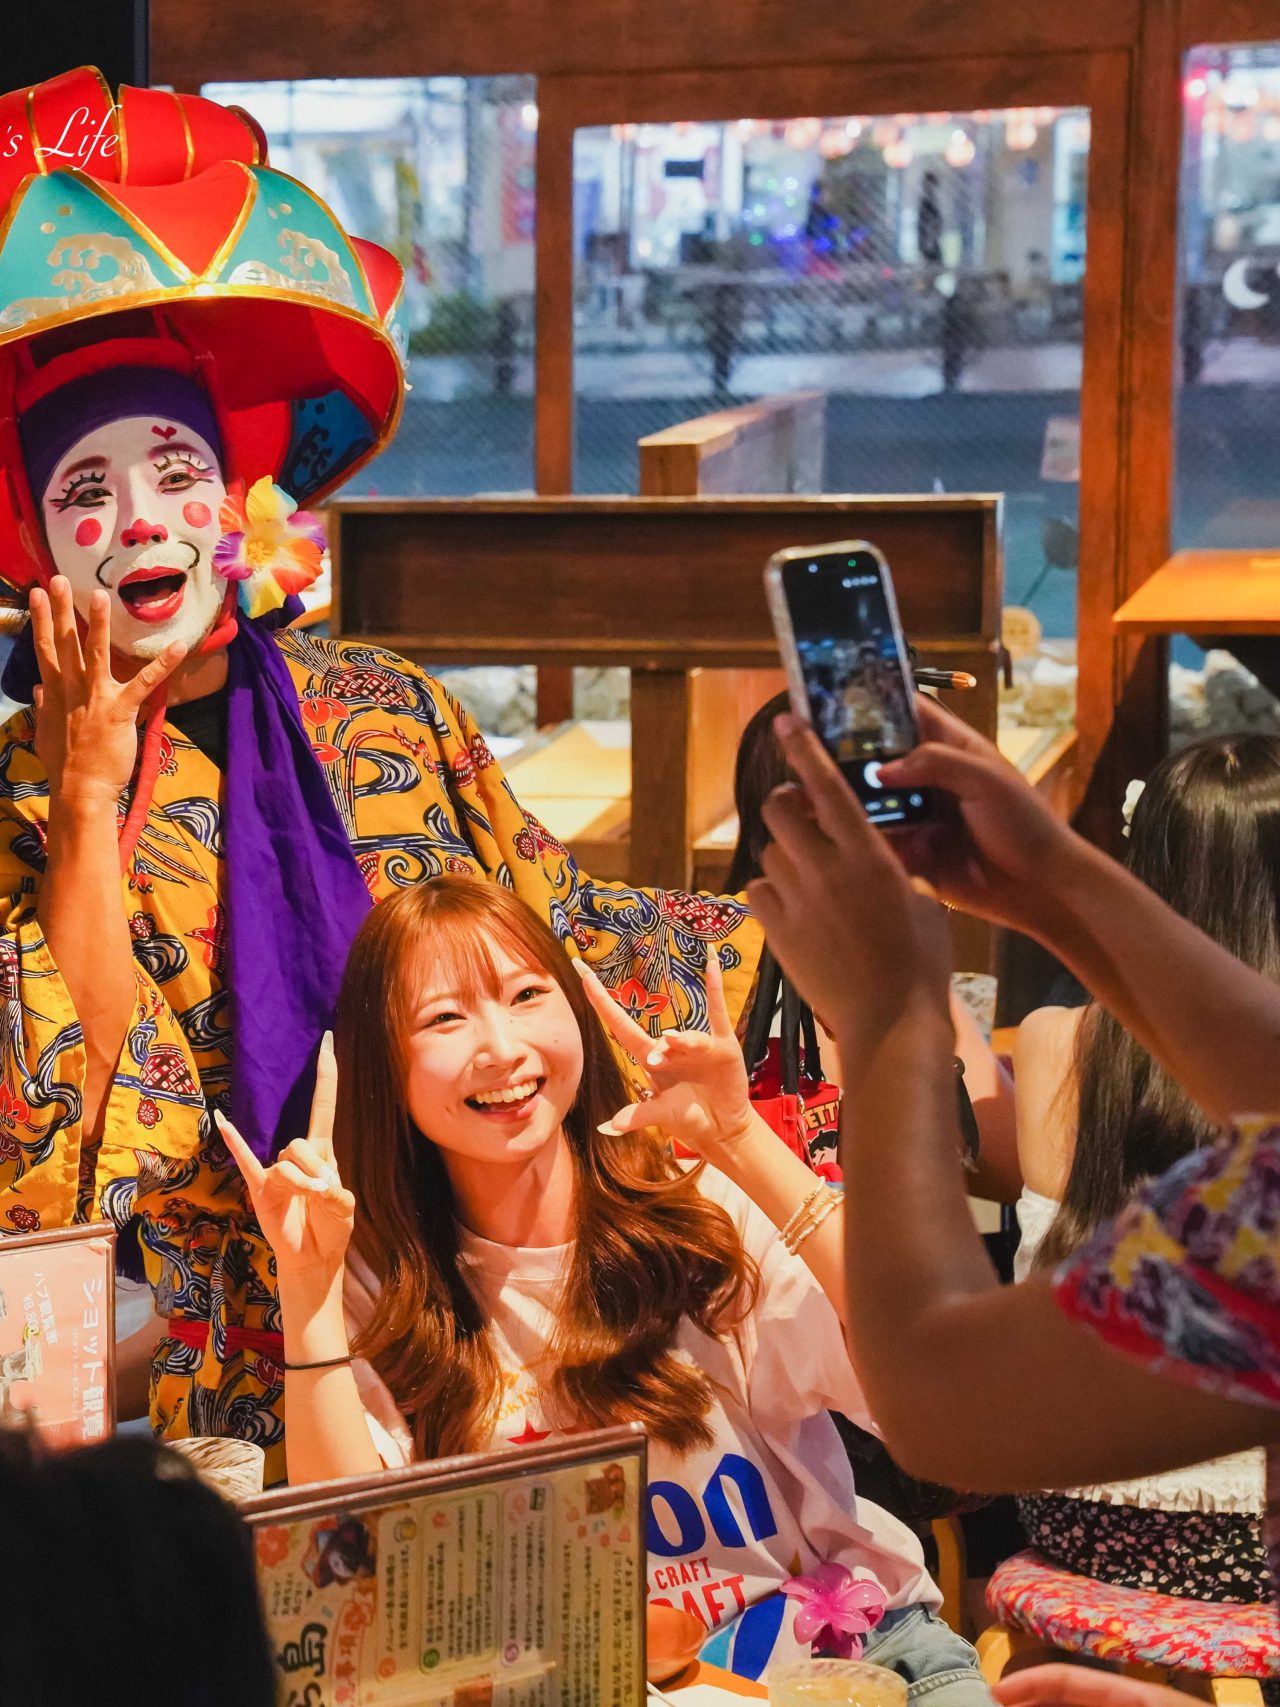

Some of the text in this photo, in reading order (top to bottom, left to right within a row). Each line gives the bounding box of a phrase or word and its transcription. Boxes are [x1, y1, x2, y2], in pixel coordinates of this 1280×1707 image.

[804, 1100, 839, 1141] ETT
[654, 1557, 712, 1590] CRAFT
[649, 1575, 746, 1632] AFT
